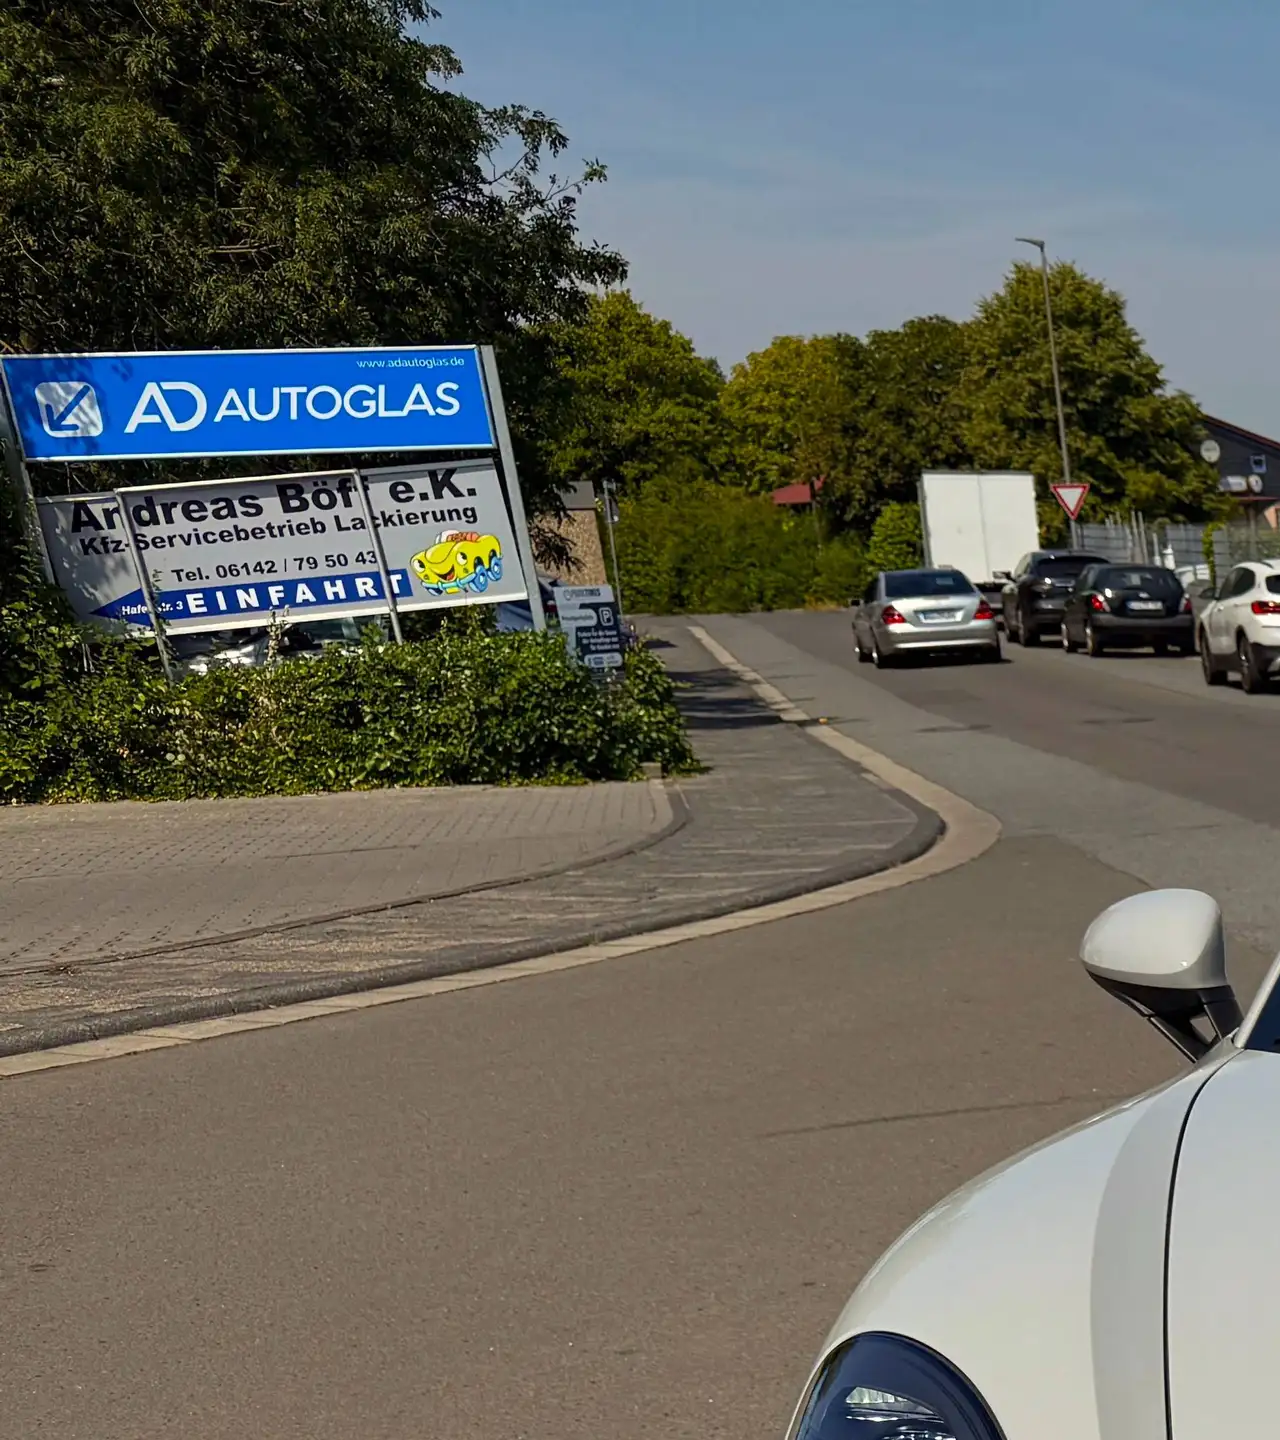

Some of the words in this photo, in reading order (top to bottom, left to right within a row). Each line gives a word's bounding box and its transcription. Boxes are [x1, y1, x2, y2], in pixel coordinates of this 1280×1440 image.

[356, 356, 465, 369] www.adautoglas.de
[123, 381, 207, 434] AD
[213, 381, 461, 422] AUTOGLAS
[71, 493, 264, 533] Andreas
[388, 468, 477, 504] e.K.
[80, 516, 326, 555] Kfz-Servicebetrieb
[334, 506, 478, 532] Lackierung
[171, 567, 210, 583] Tel.
[215, 560, 278, 579] 06142
[293, 556, 319, 571] 79
[325, 553, 349, 568] 50
[354, 550, 378, 565] 43
[176, 600, 183, 610] 3
[185, 573, 403, 614] EINFAHRT
